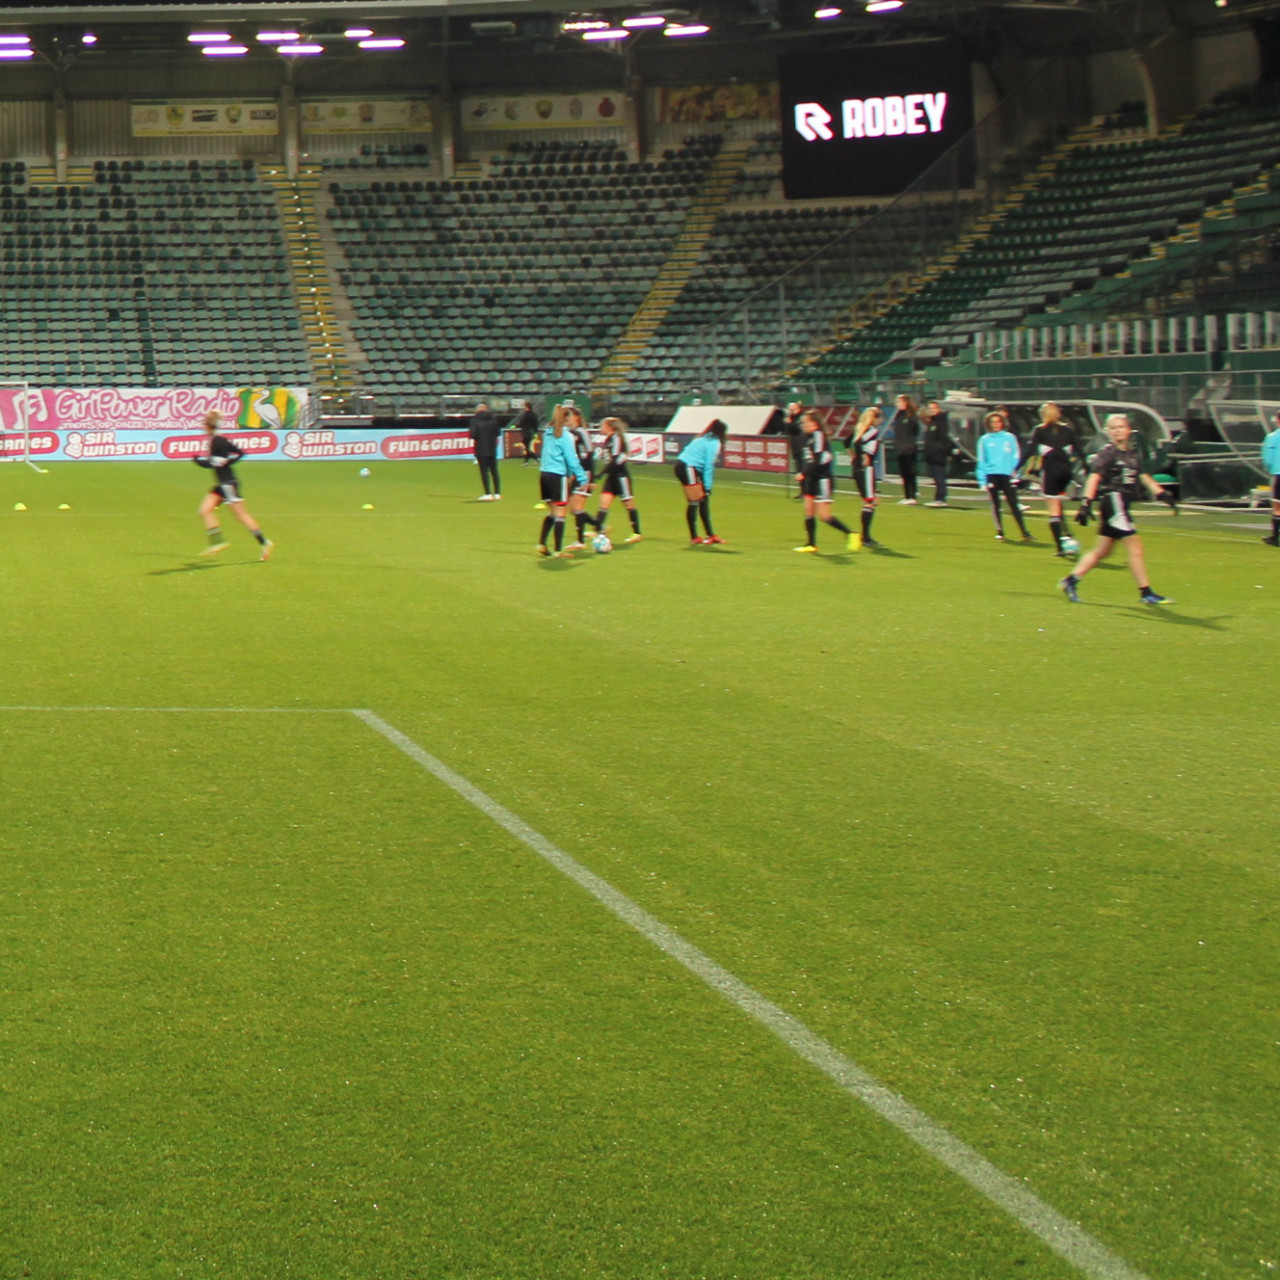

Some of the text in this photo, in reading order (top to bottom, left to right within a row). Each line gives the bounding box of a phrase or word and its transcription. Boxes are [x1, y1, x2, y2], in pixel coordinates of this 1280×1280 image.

[842, 92, 947, 139] ROBEY
[164, 388, 240, 420] Radio
[84, 432, 114, 444] SIR
[304, 432, 333, 443] SIR
[83, 442, 156, 456] WINSTON
[302, 442, 376, 456] WINSTON
